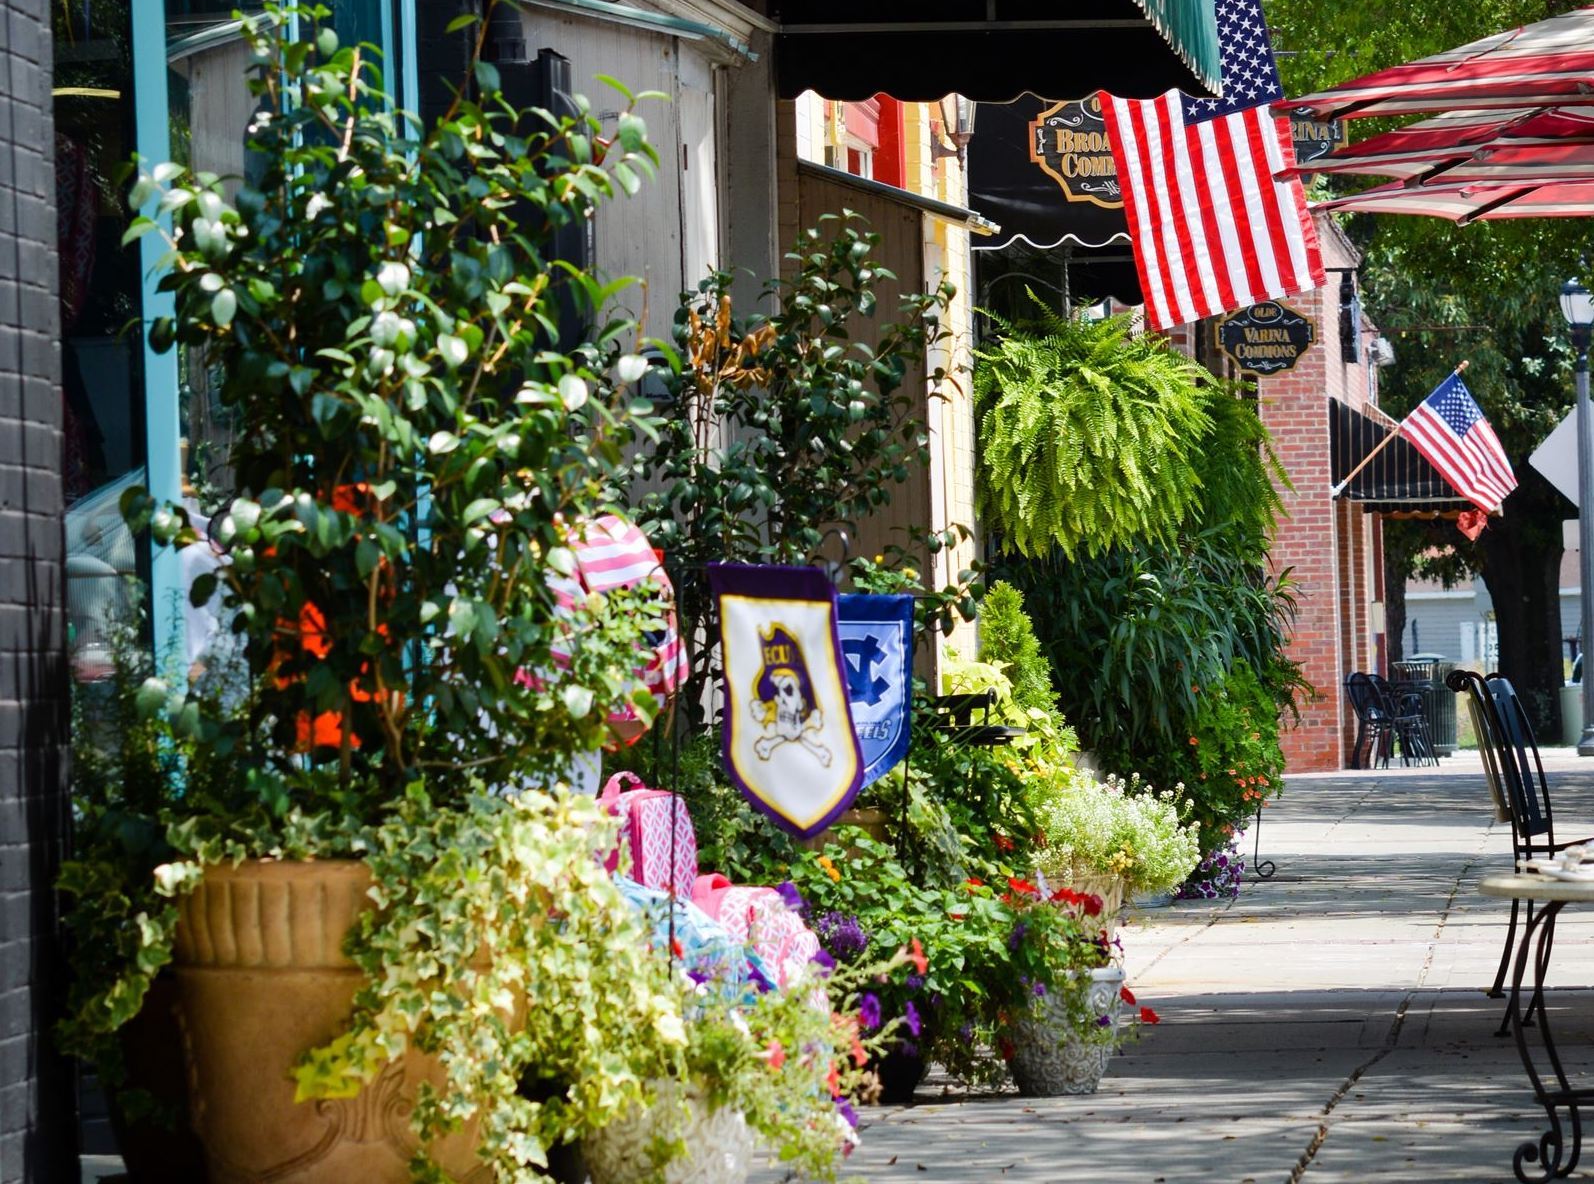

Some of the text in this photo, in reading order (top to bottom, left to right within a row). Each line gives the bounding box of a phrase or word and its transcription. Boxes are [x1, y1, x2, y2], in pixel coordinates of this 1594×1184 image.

[1253, 307, 1277, 317] OLDE
[1243, 327, 1291, 343] VARINA
[1235, 343, 1297, 359] COMMONS
